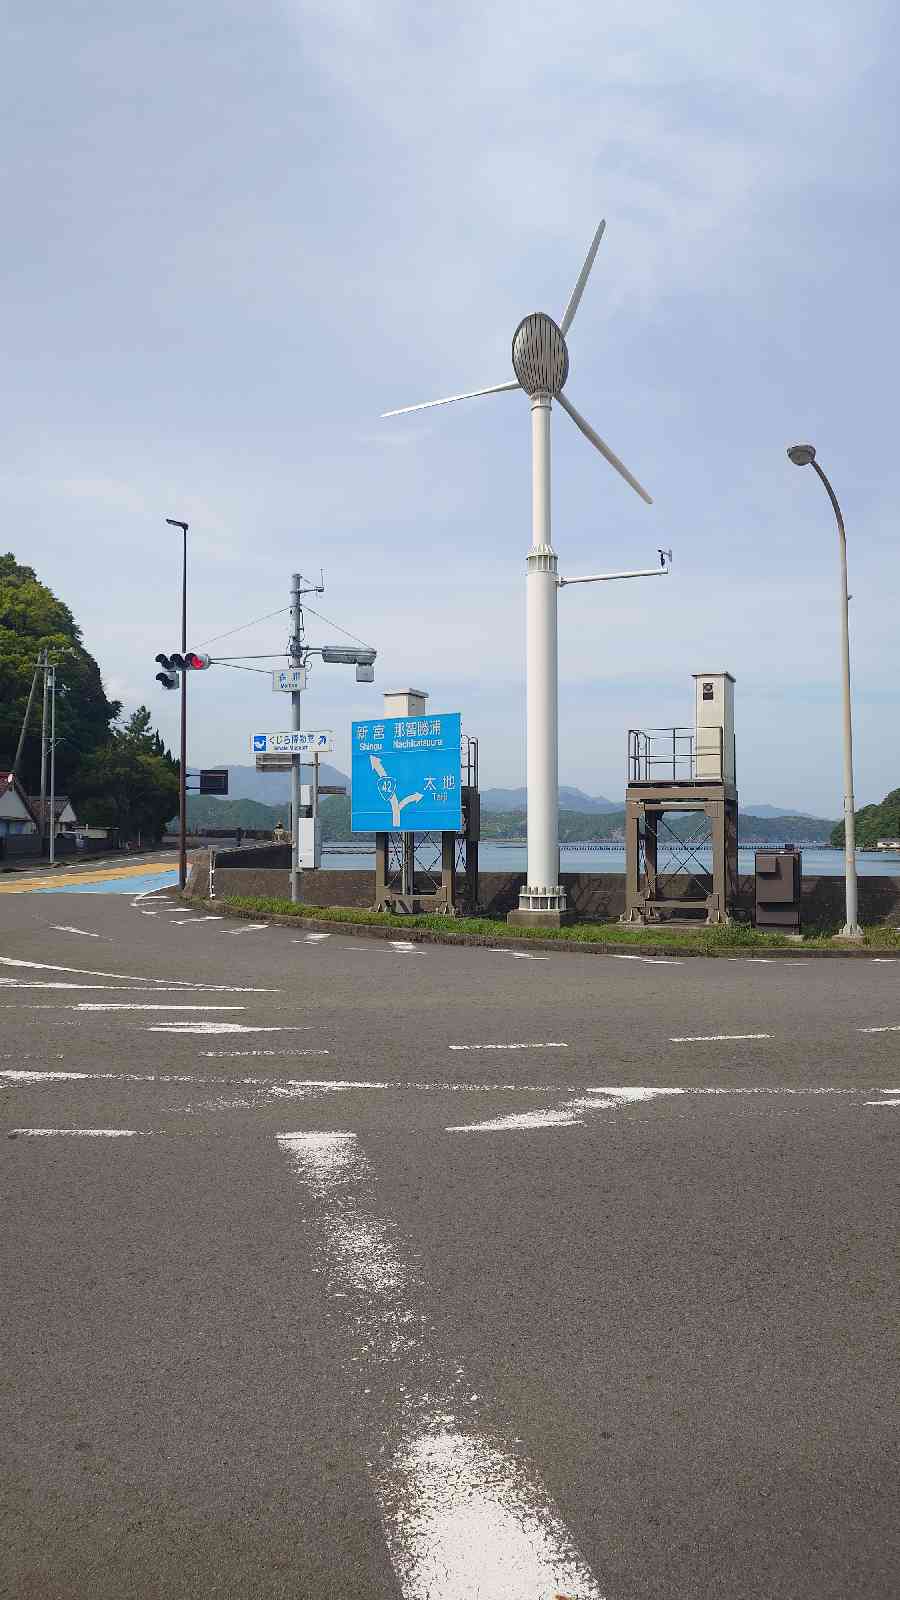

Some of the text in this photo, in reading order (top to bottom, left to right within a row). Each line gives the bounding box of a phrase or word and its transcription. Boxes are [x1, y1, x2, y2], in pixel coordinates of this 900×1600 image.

[356, 725, 385, 740] 新宮
[393, 720, 441, 737] 那智勝浦
[359, 742, 383, 752] Shingu
[382, 781, 392, 792] 42
[423, 775, 455, 791] 太地
[432, 792, 448, 803] Taiji
